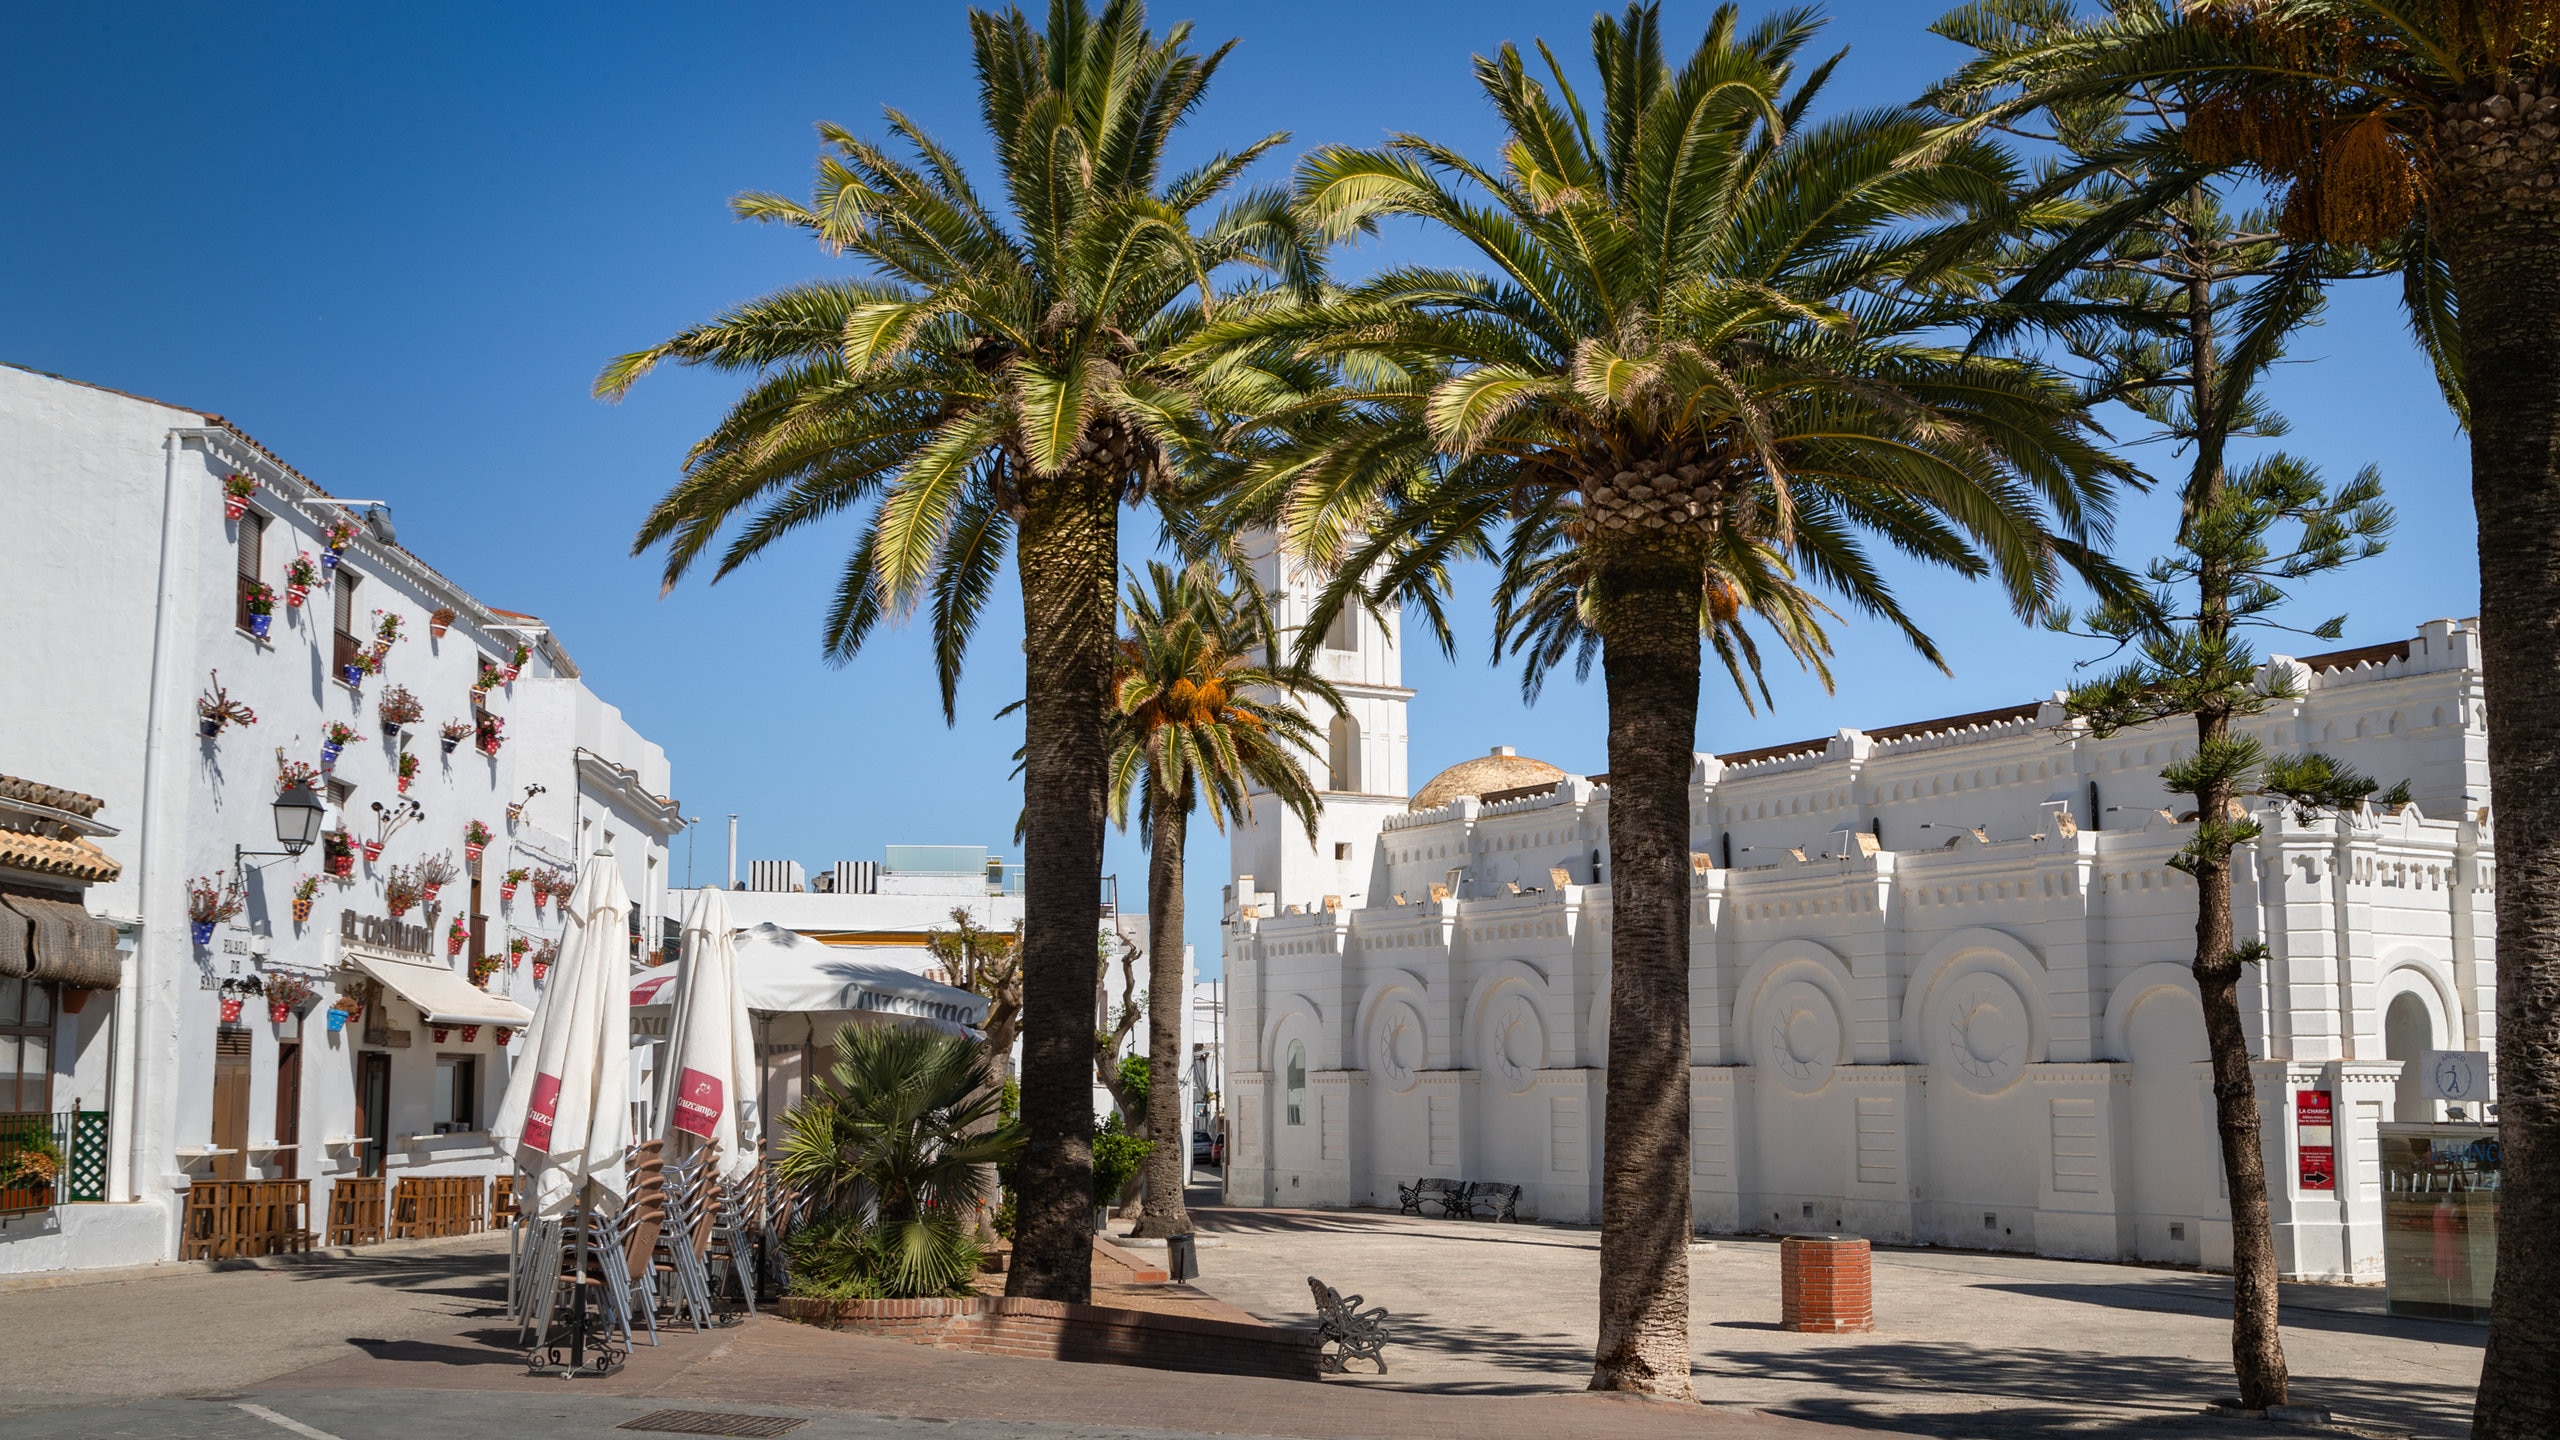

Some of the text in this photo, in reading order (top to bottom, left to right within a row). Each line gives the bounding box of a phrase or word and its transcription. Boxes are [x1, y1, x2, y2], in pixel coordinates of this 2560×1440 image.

[342, 909, 358, 940] EL
[223, 939, 247, 955] PLAZA
[231, 960, 240, 974] DE
[200, 976, 226, 991] SANT
[841, 982, 974, 1024] Cruzcampo
[2441, 1051, 2466, 1063] AHINCO
[677, 1097, 717, 1118] Cruzcampo
